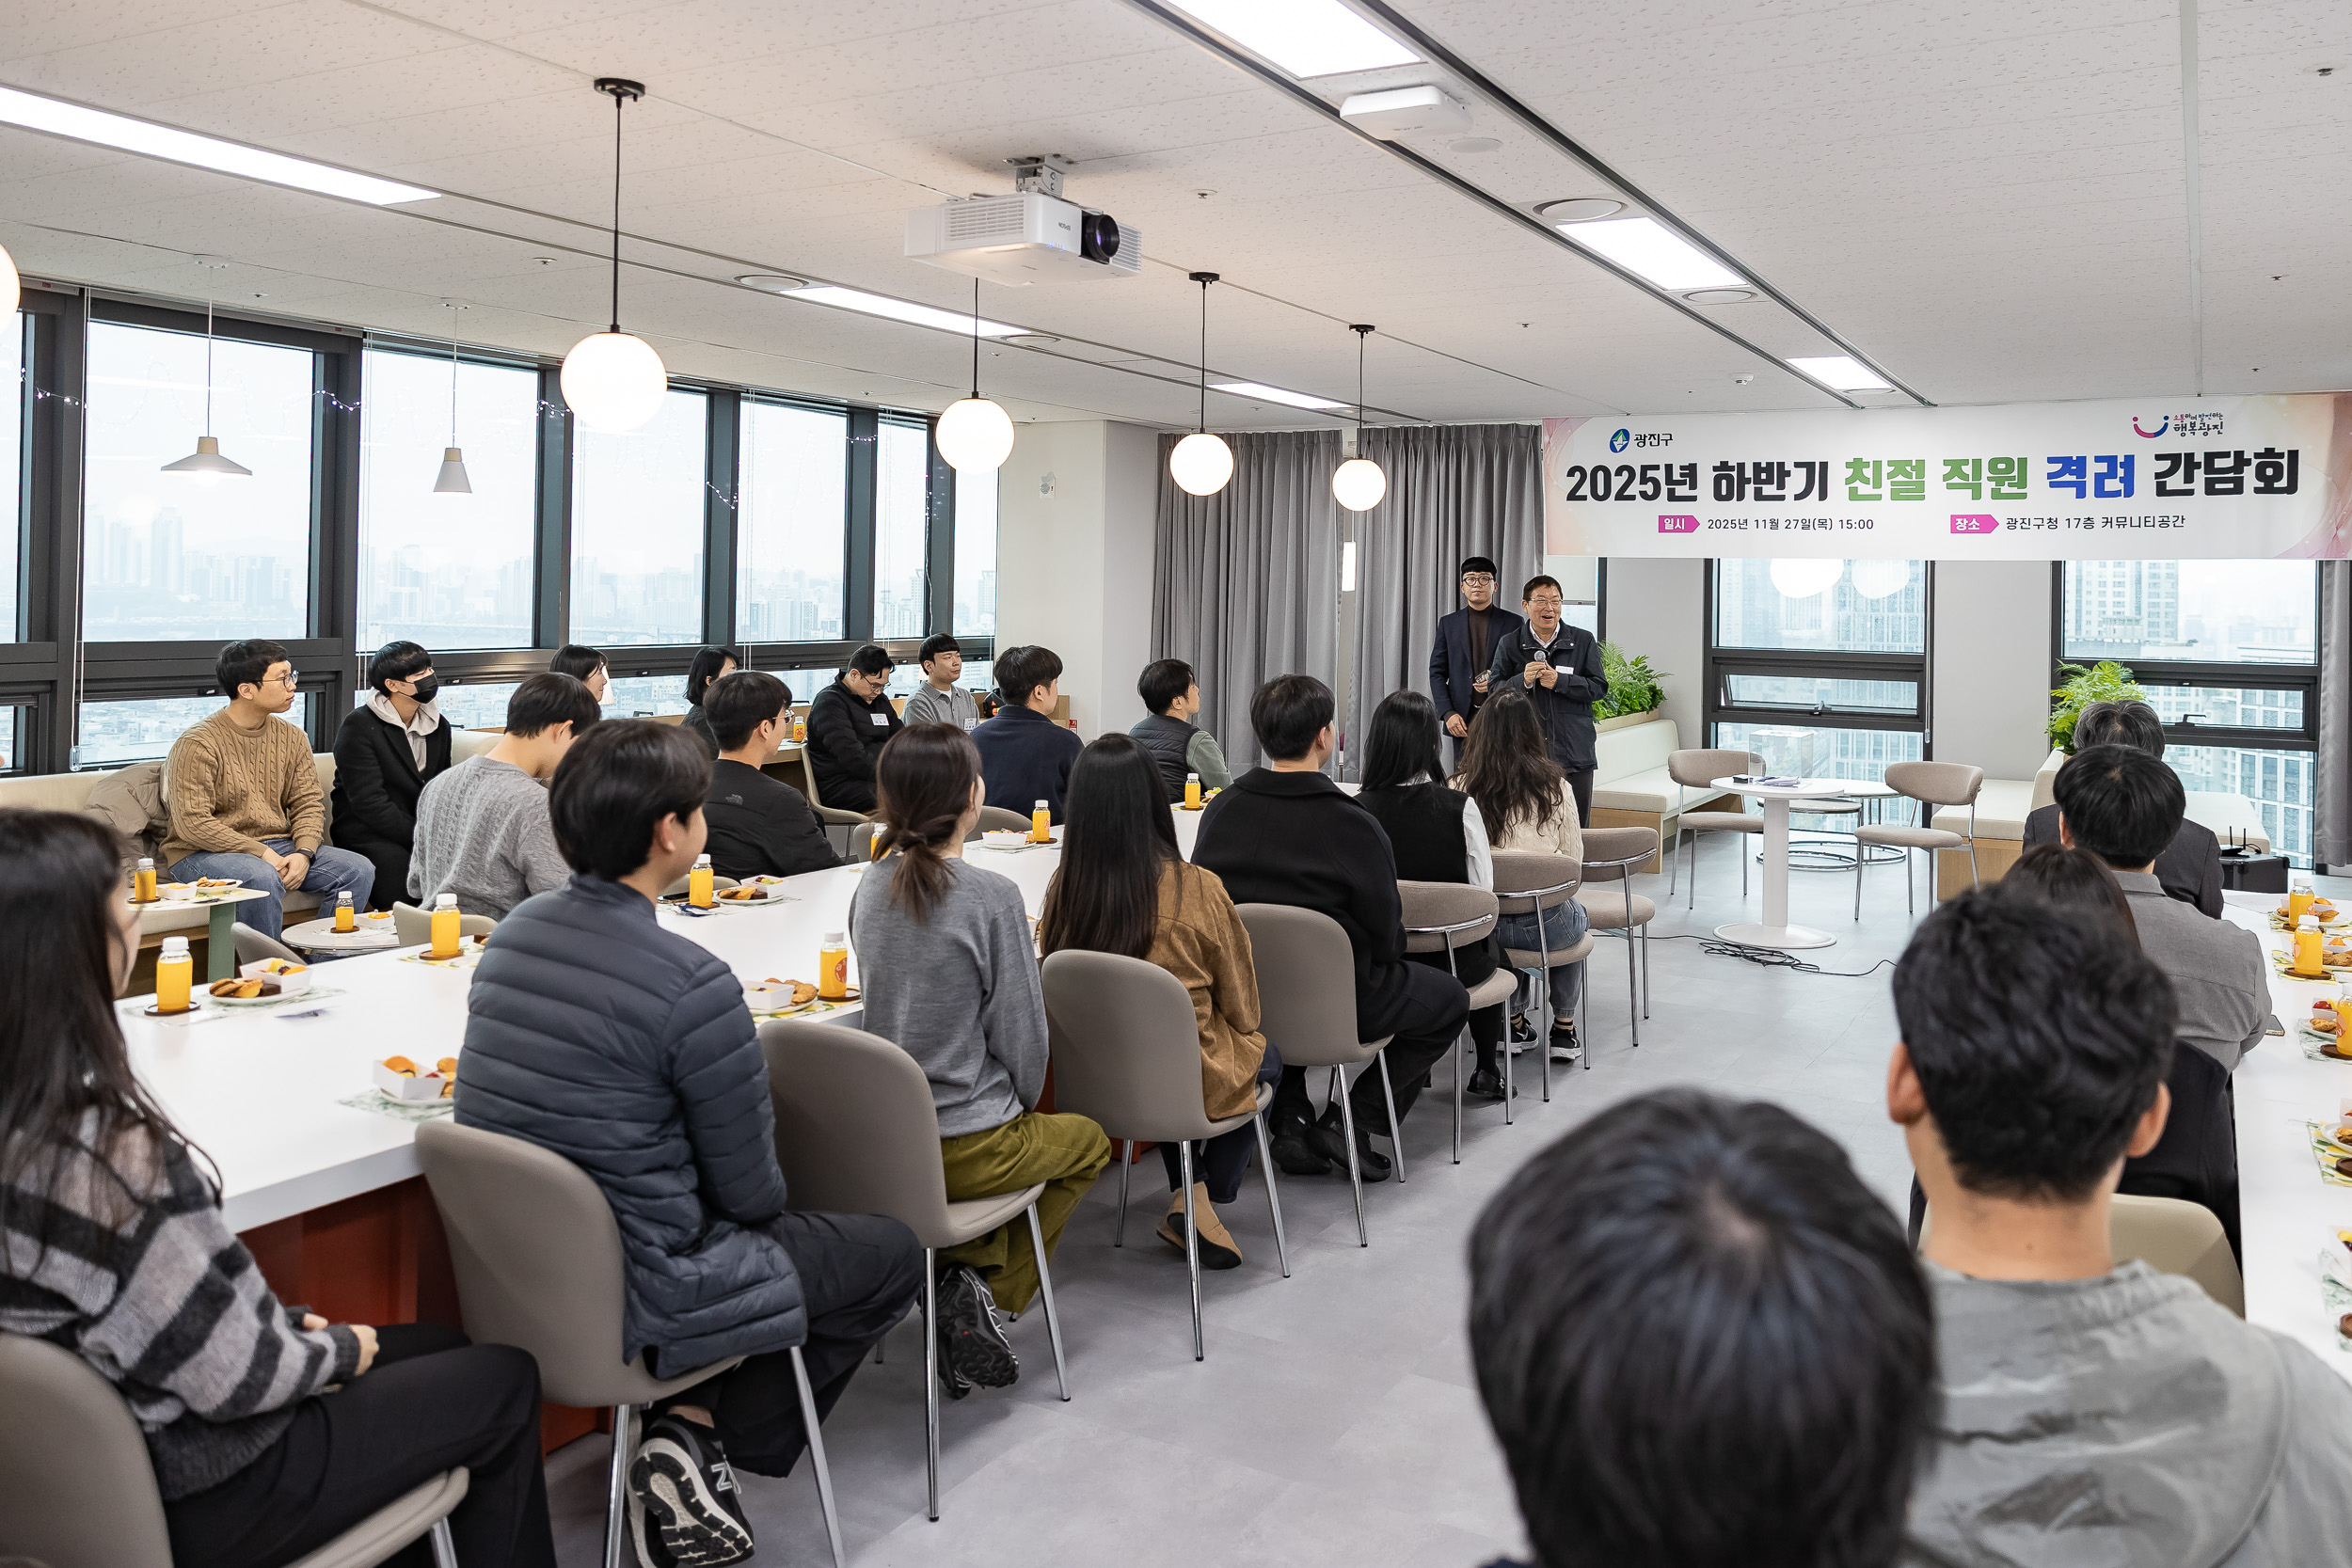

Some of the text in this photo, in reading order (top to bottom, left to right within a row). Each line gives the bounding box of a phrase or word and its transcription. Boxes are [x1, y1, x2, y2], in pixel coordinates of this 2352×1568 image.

[2173, 421, 2224, 436] 행복광진
[1633, 433, 1674, 448] 광진구
[1565, 447, 2300, 502] 2025년 하반기 친절 직원 격려 간담회
[1663, 517, 1686, 531] 일시
[1708, 517, 1874, 531] 2025년 11월 27일(목) 15:00
[1954, 517, 1981, 531] 장소
[2006, 515, 2185, 531] 광진구청 17층 커뮤니티공간
